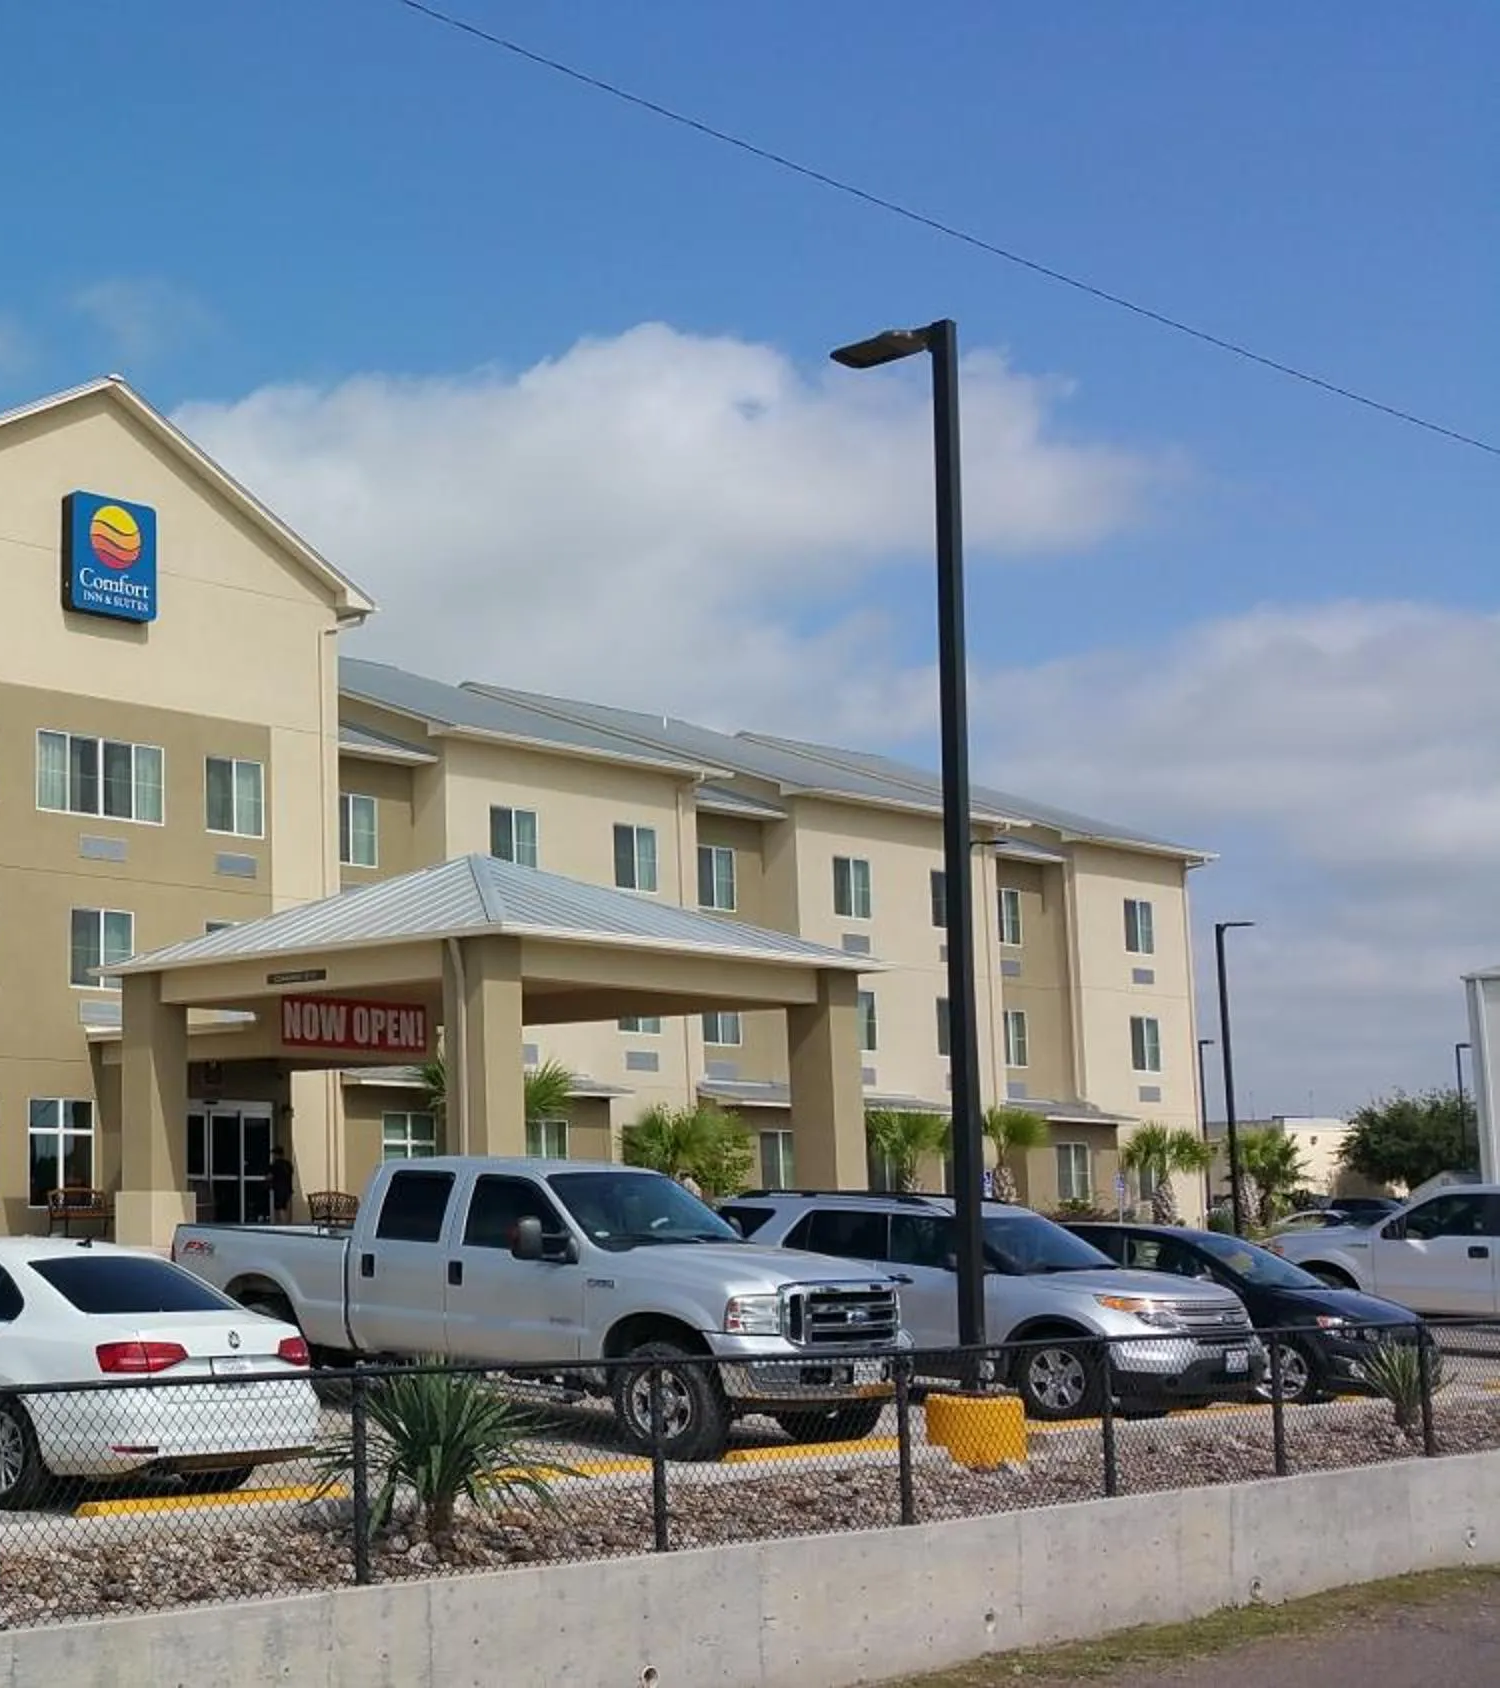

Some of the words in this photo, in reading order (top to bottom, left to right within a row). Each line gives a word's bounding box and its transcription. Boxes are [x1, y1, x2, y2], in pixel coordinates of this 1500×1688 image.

[79, 567, 149, 599] Comfort
[83, 589, 103, 604] INN
[104, 594, 112, 605] &
[113, 595, 149, 612] SUITES
[283, 1001, 348, 1043] NOW
[353, 1005, 425, 1047] OPEN!
